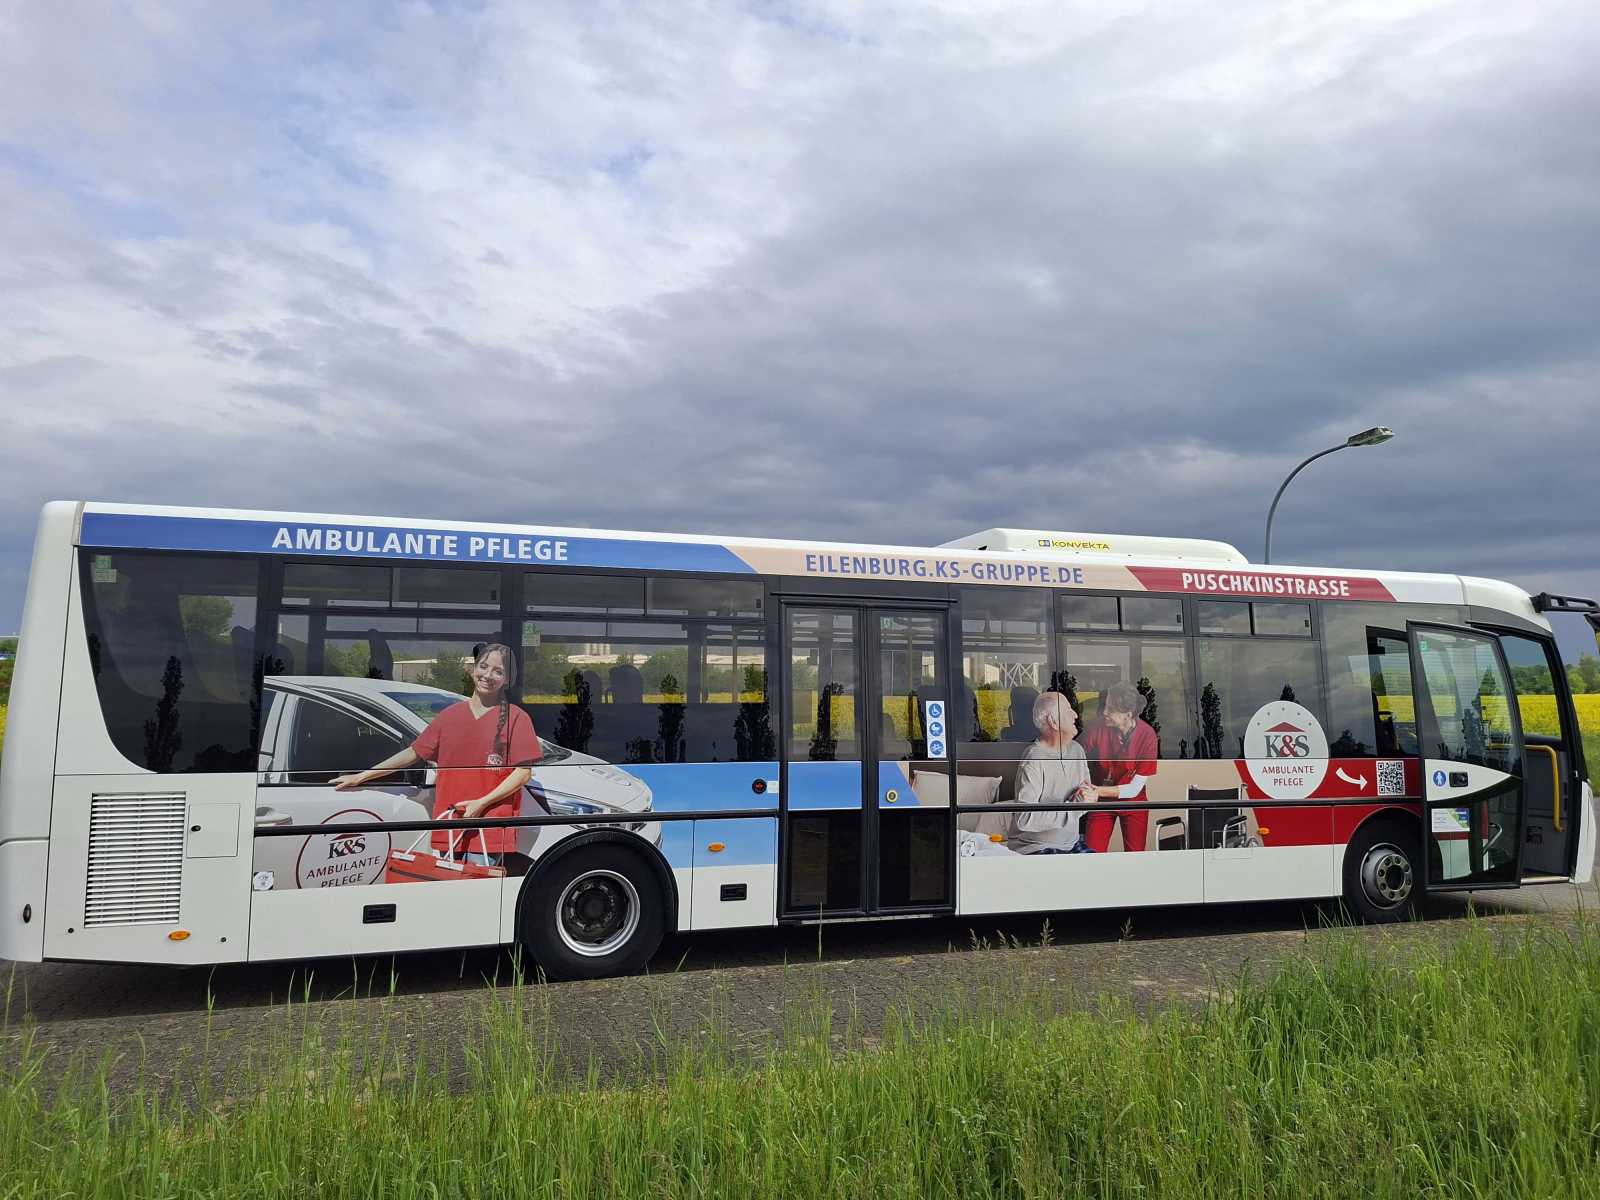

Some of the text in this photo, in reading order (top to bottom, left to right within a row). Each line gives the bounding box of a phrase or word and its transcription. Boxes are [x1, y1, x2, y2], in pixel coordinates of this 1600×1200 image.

[271, 527, 568, 561] AMBULANTE PFLEGE
[1051, 540, 1110, 549] KONVEKTA
[805, 554, 1084, 584] EILENBURG.KS-GRUPPE.DE
[1181, 572, 1350, 597] PUSCHKINSTRASSE
[1263, 735, 1310, 757] K&S
[1261, 765, 1315, 774] AMBULANTE
[1273, 778, 1304, 786] PFLEGE
[327, 837, 366, 859] K&S
[306, 856, 381, 879] AMBULANTE
[321, 872, 364, 888] PFLEGE
